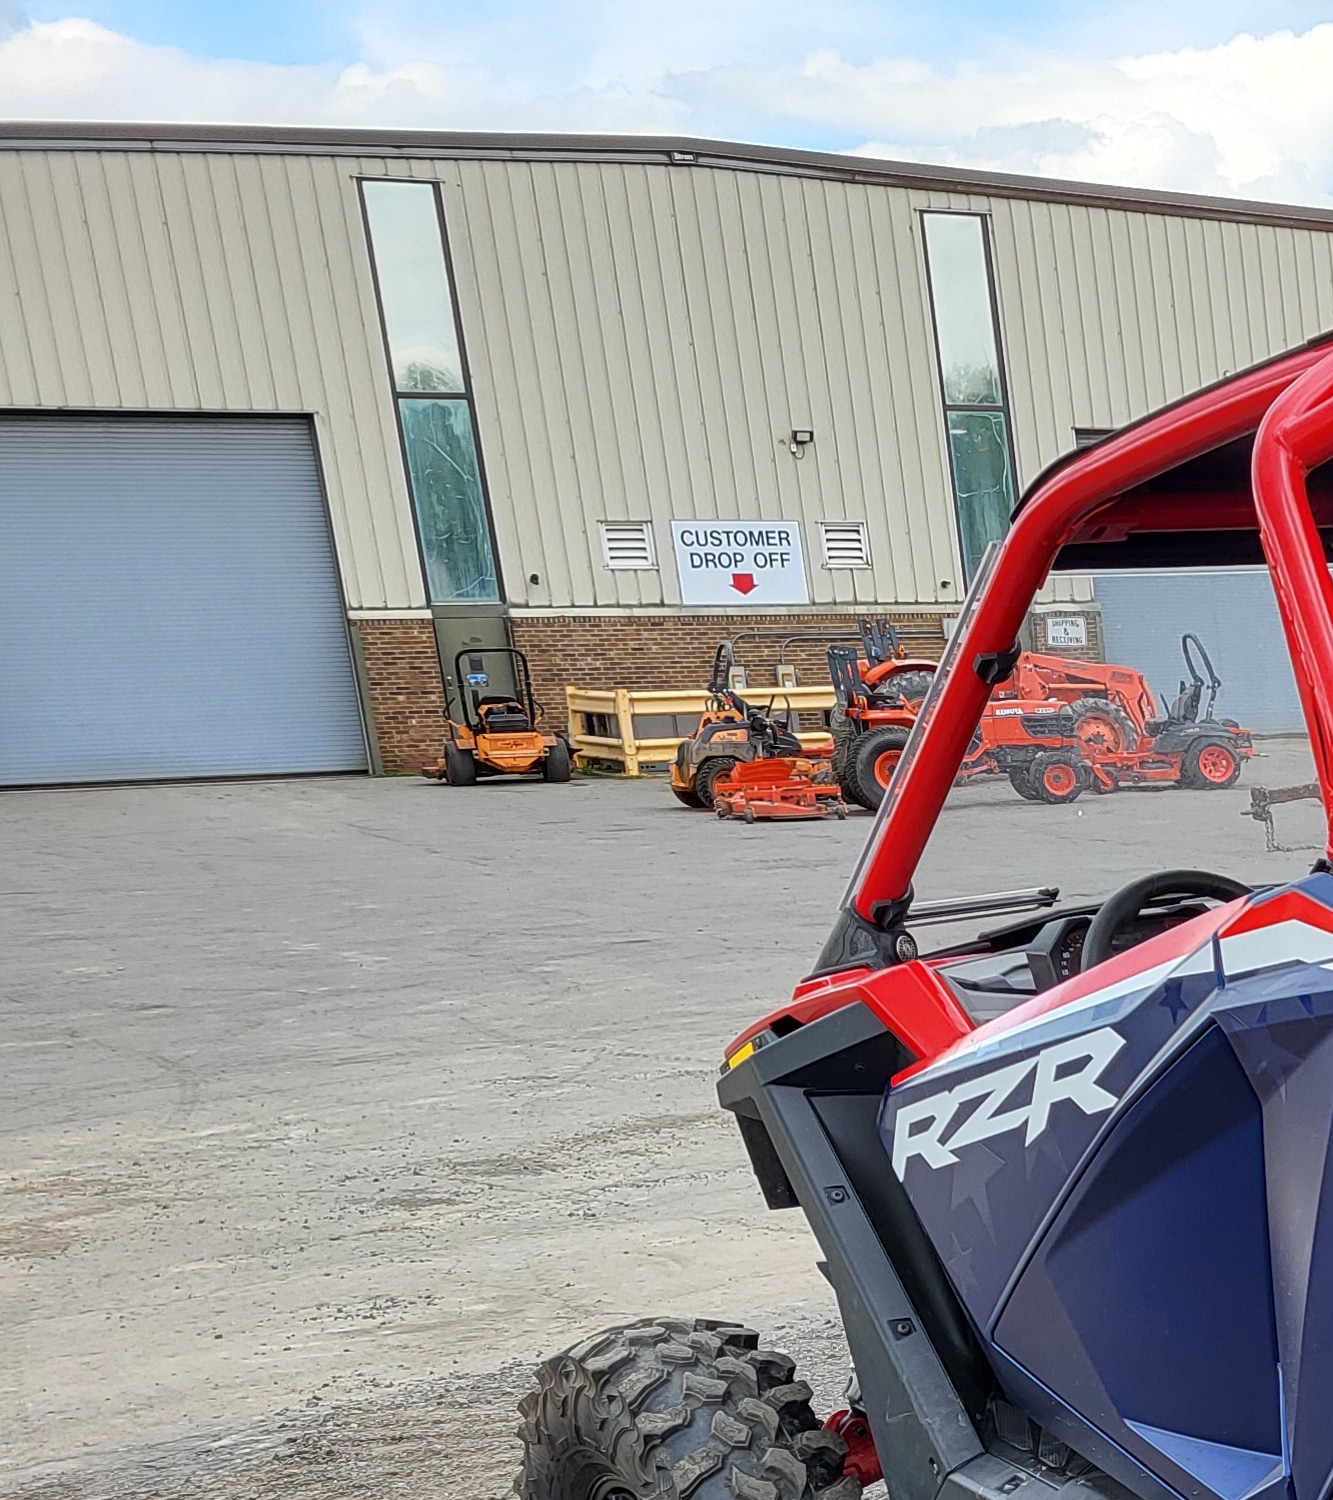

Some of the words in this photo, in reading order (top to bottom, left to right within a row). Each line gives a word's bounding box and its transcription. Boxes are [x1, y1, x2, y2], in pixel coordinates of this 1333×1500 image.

[680, 529, 792, 547] CUSTOMER
[689, 552, 745, 569] DROP
[753, 552, 791, 569] OFF
[1051, 619, 1080, 628] SHIPPING
[1051, 635, 1083, 644] RECEIVING
[995, 707, 1024, 716] KUBOTA
[891, 1026, 1127, 1183] RZR
